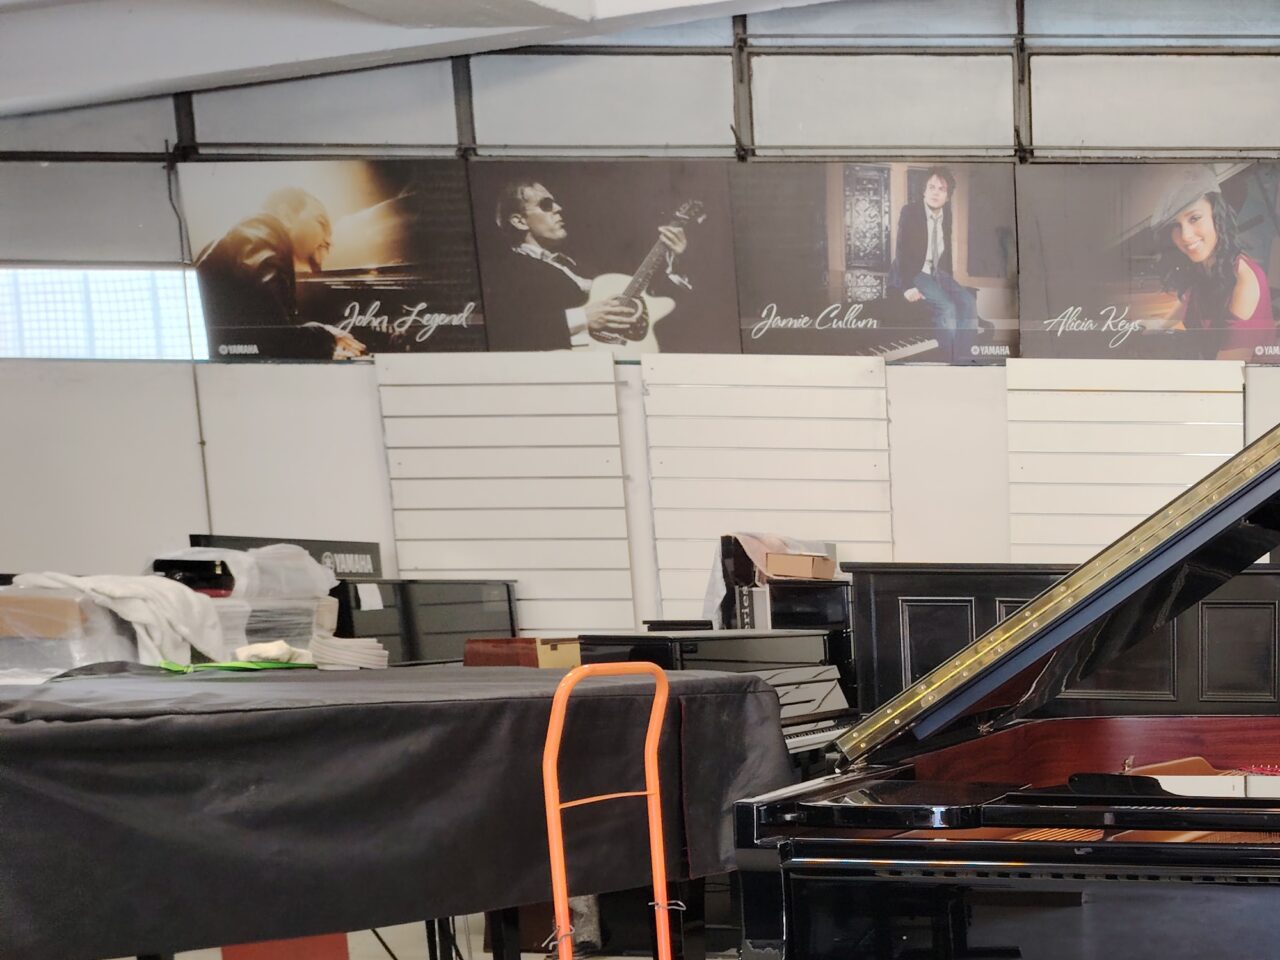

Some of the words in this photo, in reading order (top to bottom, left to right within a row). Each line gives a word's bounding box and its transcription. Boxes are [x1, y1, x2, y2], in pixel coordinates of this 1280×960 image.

[337, 301, 389, 332] John
[394, 302, 475, 342] Legend
[751, 303, 813, 339] Jamie
[816, 303, 878, 330] Cullum
[1043, 305, 1098, 337] Alicia
[1099, 305, 1142, 348] Keys
[228, 344, 259, 355] YAMAHA
[980, 345, 1010, 355] YAMAHA
[334, 553, 374, 573] YAMAHA
